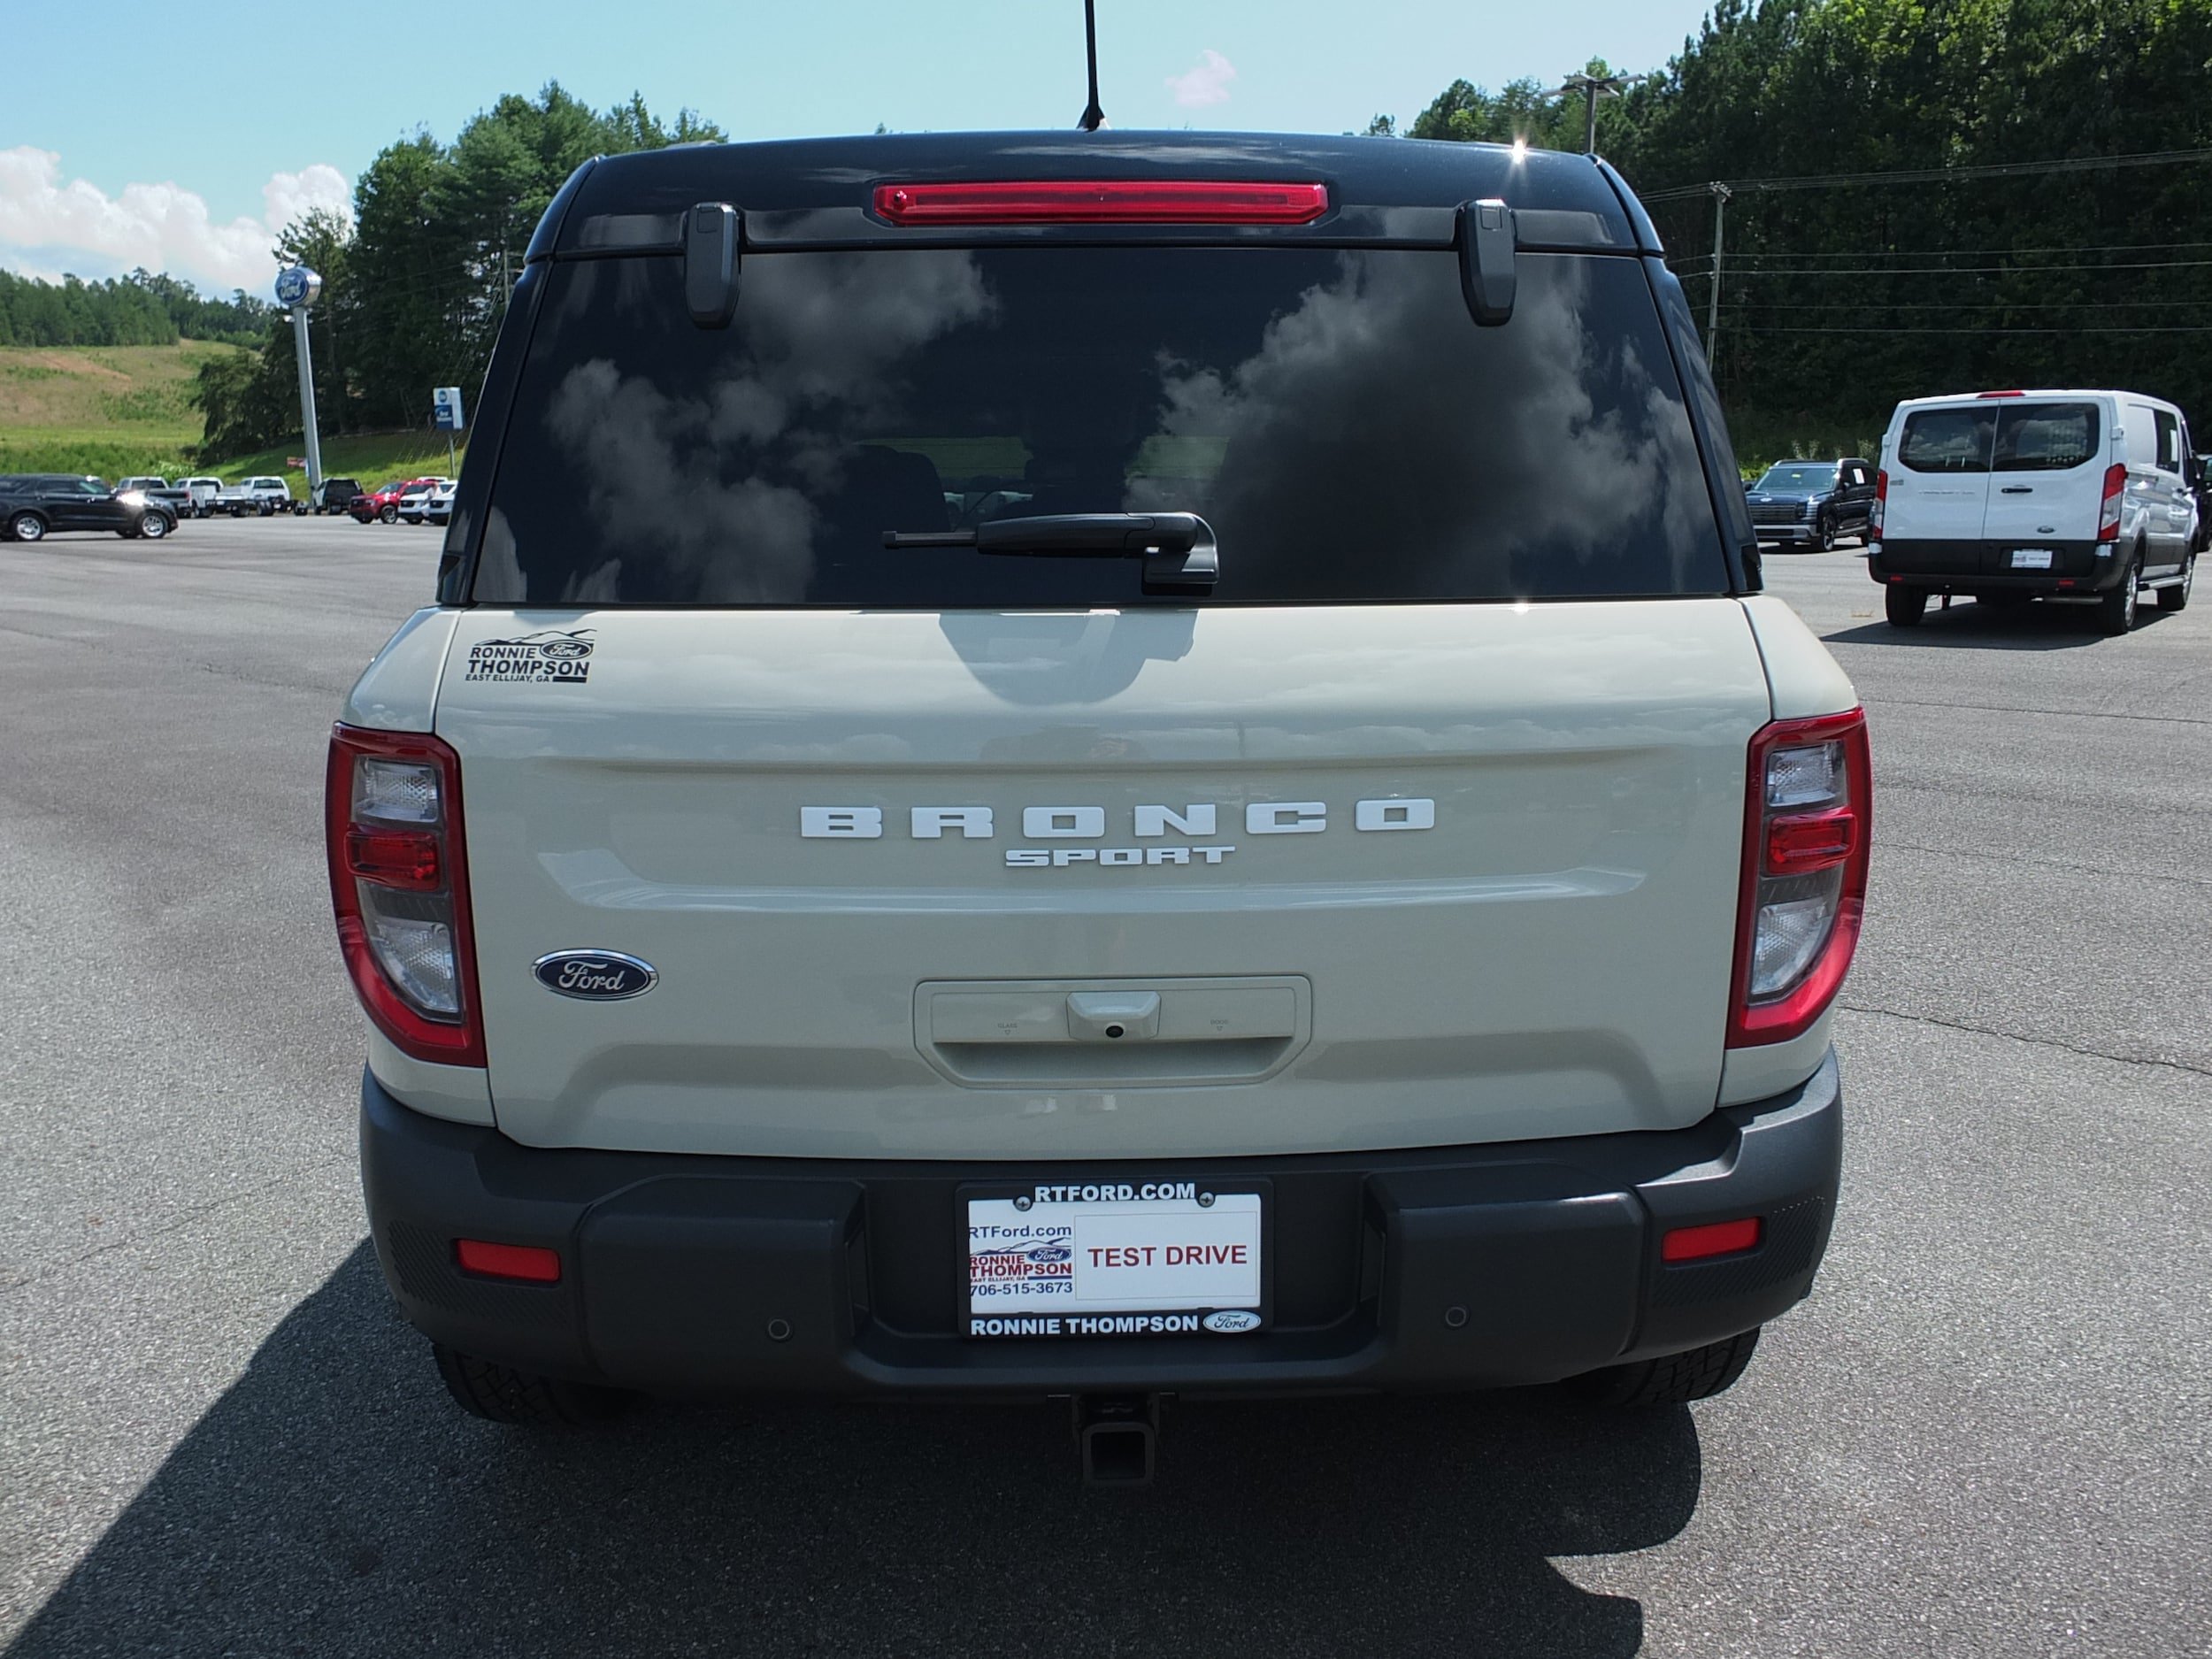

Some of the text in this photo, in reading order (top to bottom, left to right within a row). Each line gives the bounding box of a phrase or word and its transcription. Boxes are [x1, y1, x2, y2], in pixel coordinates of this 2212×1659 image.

[280, 275, 302, 299] Ford
[470, 647, 537, 659] RONNIE
[549, 642, 581, 657] Ford
[468, 659, 589, 676] THOMPSON
[493, 675, 533, 684] ELLIJAY,
[800, 798, 1436, 839] BRONCO
[1005, 845, 1236, 868] SPORT
[557, 960, 625, 991] Ford
[1034, 1183, 1195, 1202] RTFORD.COM
[969, 1225, 1071, 1239] RTFord.com
[970, 1255, 1025, 1266] RONNIE
[1034, 1248, 1063, 1260] Ford
[1087, 1245, 1248, 1268] TEST DRIVE
[970, 1263, 1071, 1278] THOMPSON
[970, 1281, 1072, 1296] 706-515-3673
[971, 1315, 1199, 1336] RONNIE THOMPSON
[1213, 1314, 1250, 1330] Ford
